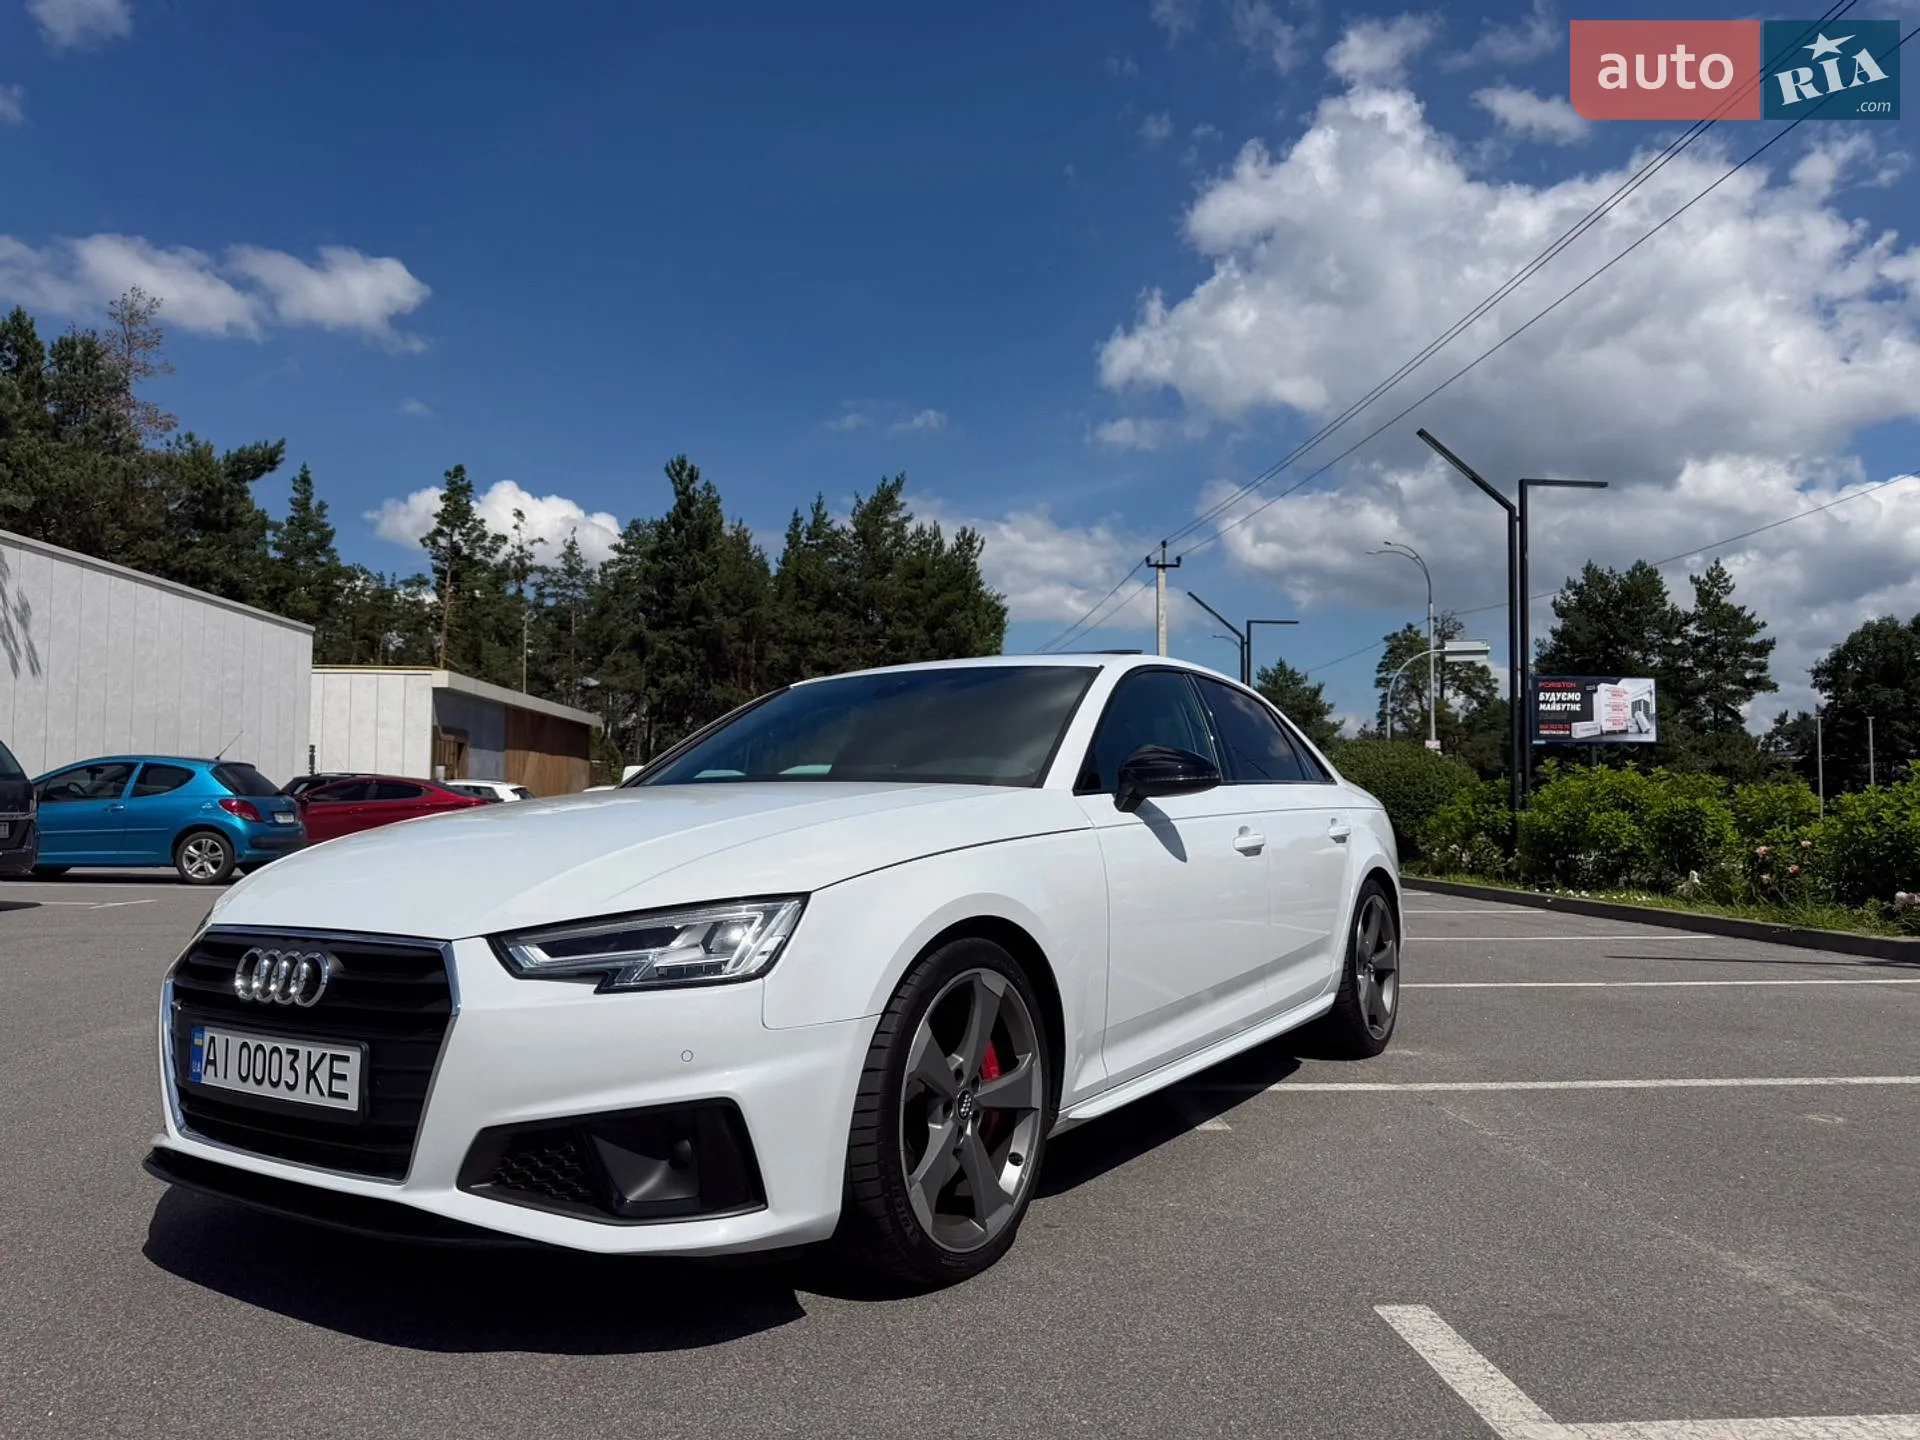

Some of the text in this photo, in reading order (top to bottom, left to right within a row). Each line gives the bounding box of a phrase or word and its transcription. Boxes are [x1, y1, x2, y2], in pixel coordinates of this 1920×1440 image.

[1538, 691, 1582, 702] БУДУЄМО
[1538, 702, 1582, 712] МАЙБУТНЄ
[204, 1036, 351, 1100] AI 0003 KE
